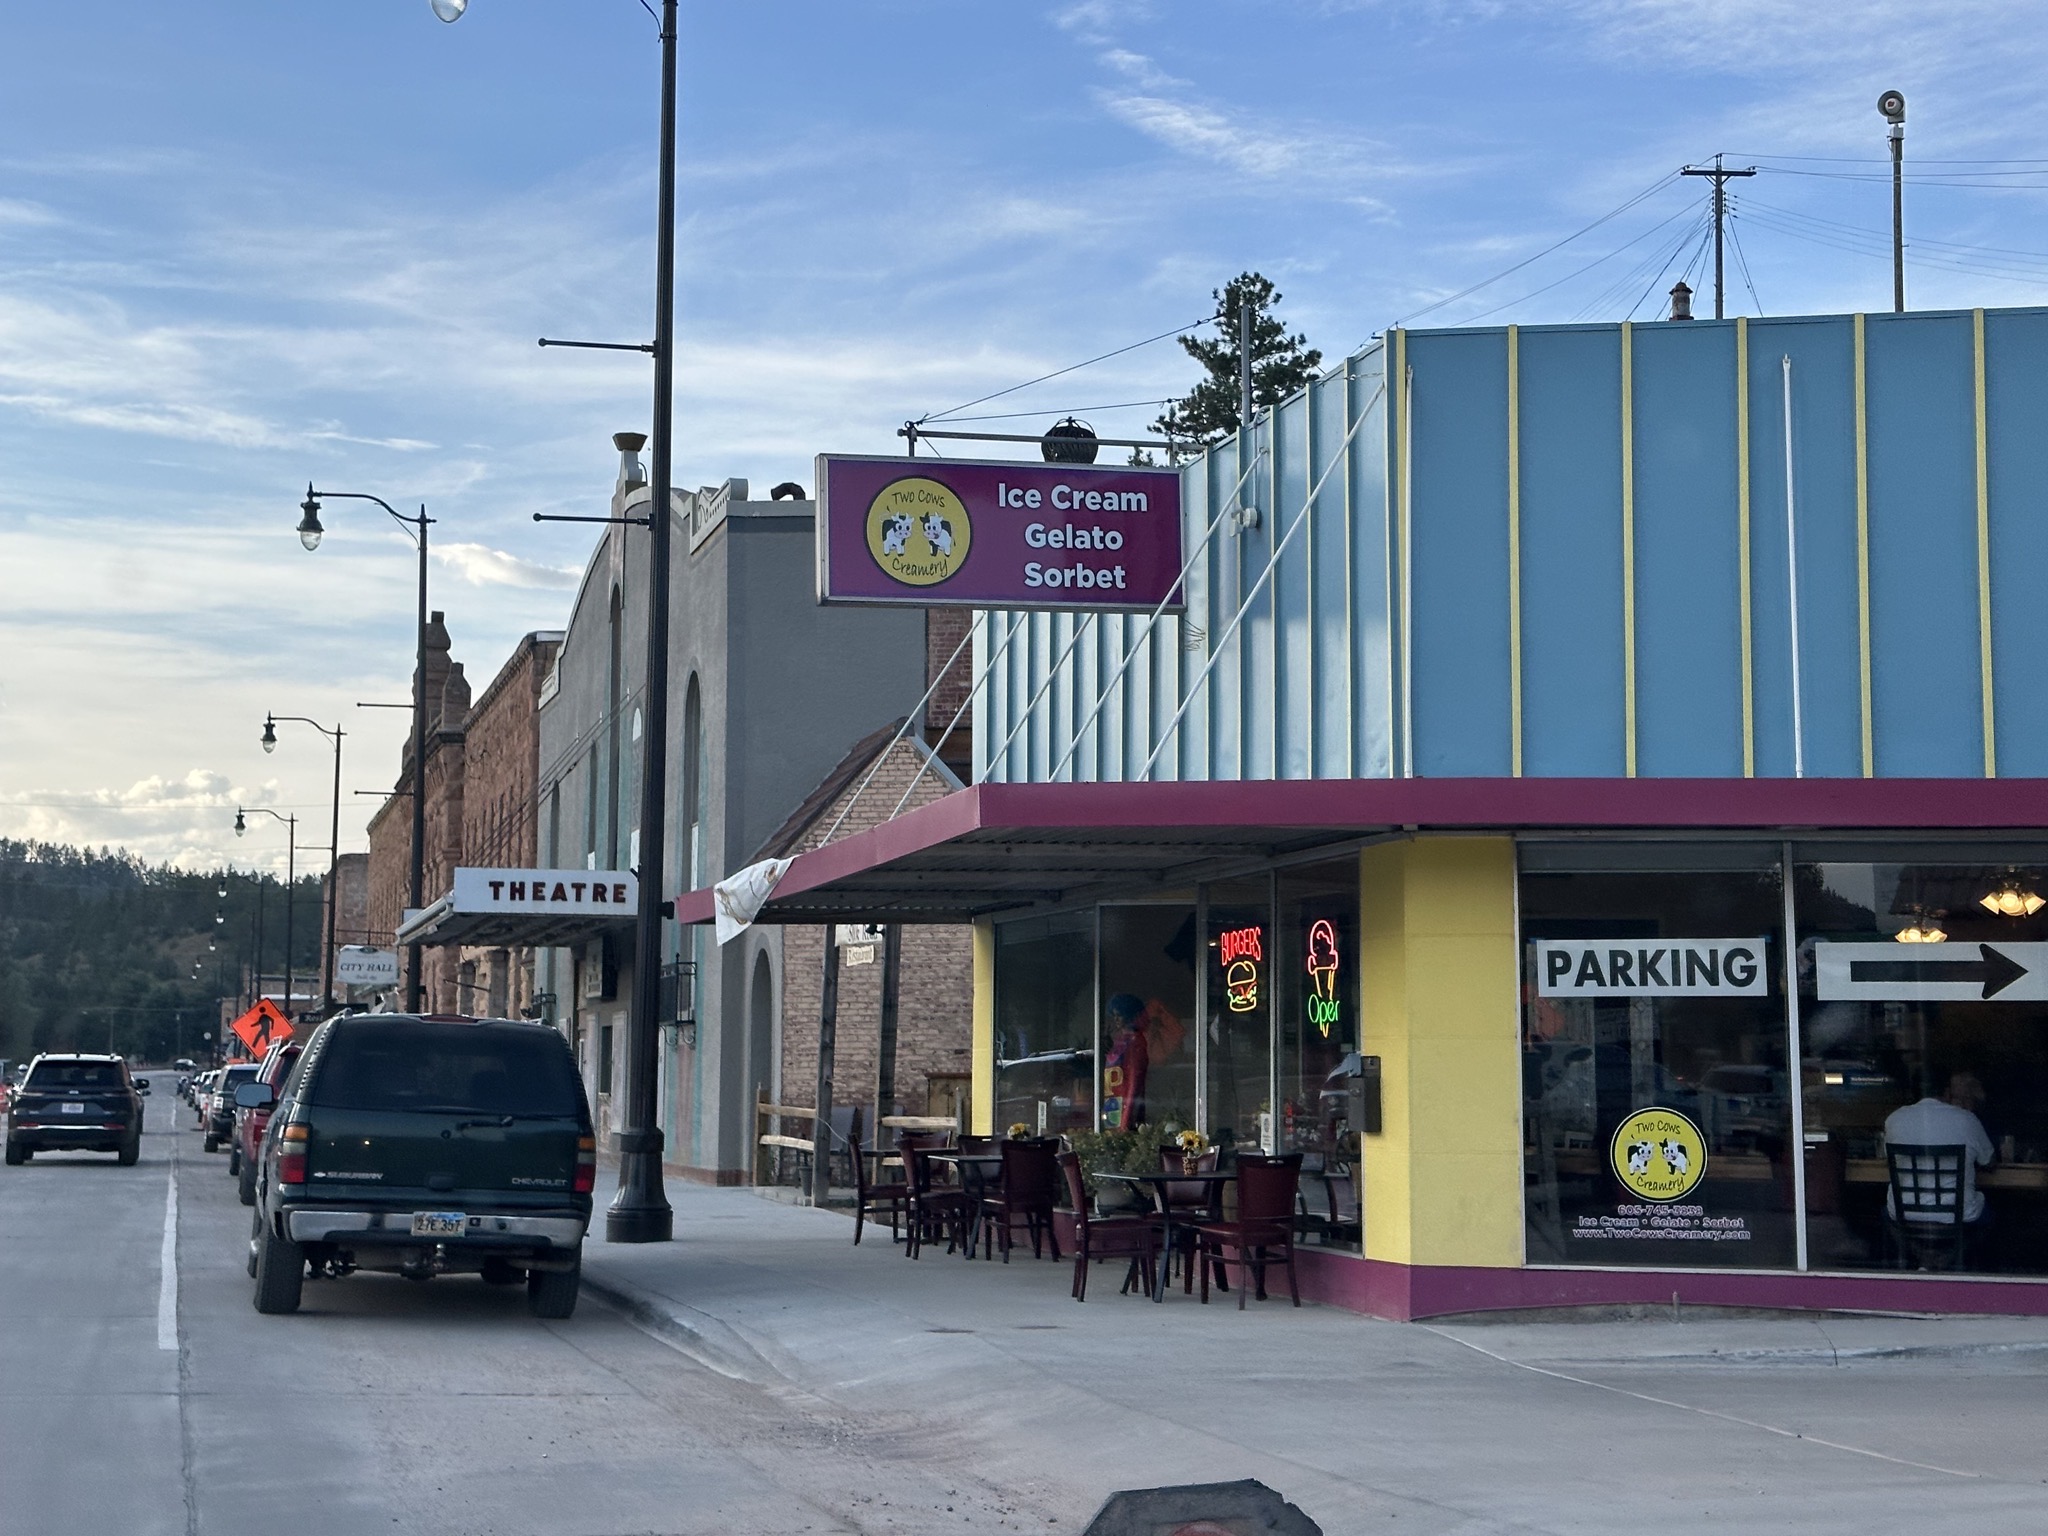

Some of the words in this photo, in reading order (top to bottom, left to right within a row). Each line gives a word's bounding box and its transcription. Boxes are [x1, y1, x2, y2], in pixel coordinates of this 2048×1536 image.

[998, 482, 1042, 509] Ice
[1050, 484, 1148, 512] Cream
[1024, 522, 1124, 550] Gelato
[891, 557, 948, 578] Creamery
[1023, 561, 1127, 589] Sorbet
[488, 880, 627, 903] THEATRE
[1221, 926, 1261, 967] BURGERS
[340, 963, 364, 972] CITY
[366, 963, 393, 972] HALL
[1546, 947, 1758, 988] PARKING
[511, 1177, 569, 1186] CHEVROLET
[1636, 1176, 1685, 1192] Creamery
[1578, 1215, 1598, 1227] Ice
[1599, 1216, 1640, 1228] Cream
[1650, 1216, 1691, 1228] Gelato
[1702, 1217, 1744, 1229] Sorbet
[1572, 1227, 1751, 1241] www.TwoCowsCreamery.com
